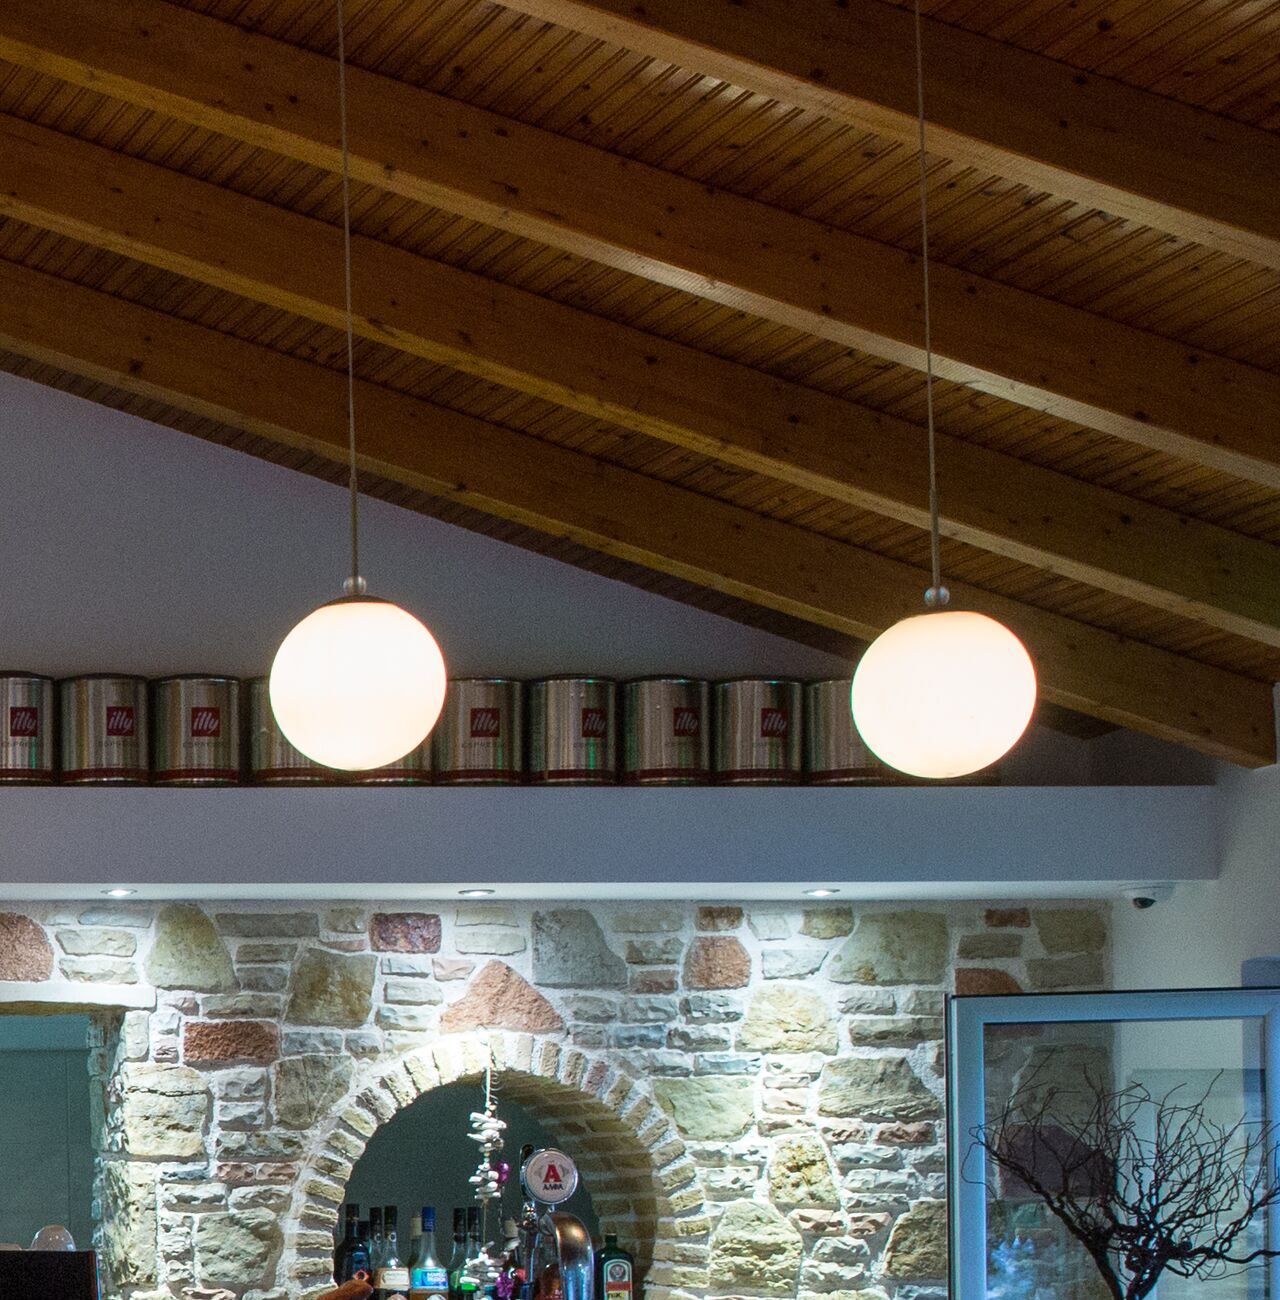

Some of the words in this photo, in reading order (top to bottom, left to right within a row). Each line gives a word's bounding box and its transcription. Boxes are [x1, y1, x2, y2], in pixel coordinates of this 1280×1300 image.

[11, 711, 36, 734] illy
[108, 711, 133, 734] illy
[193, 711, 218, 734] illy
[472, 712, 498, 733] illy
[583, 713, 606, 733] illy
